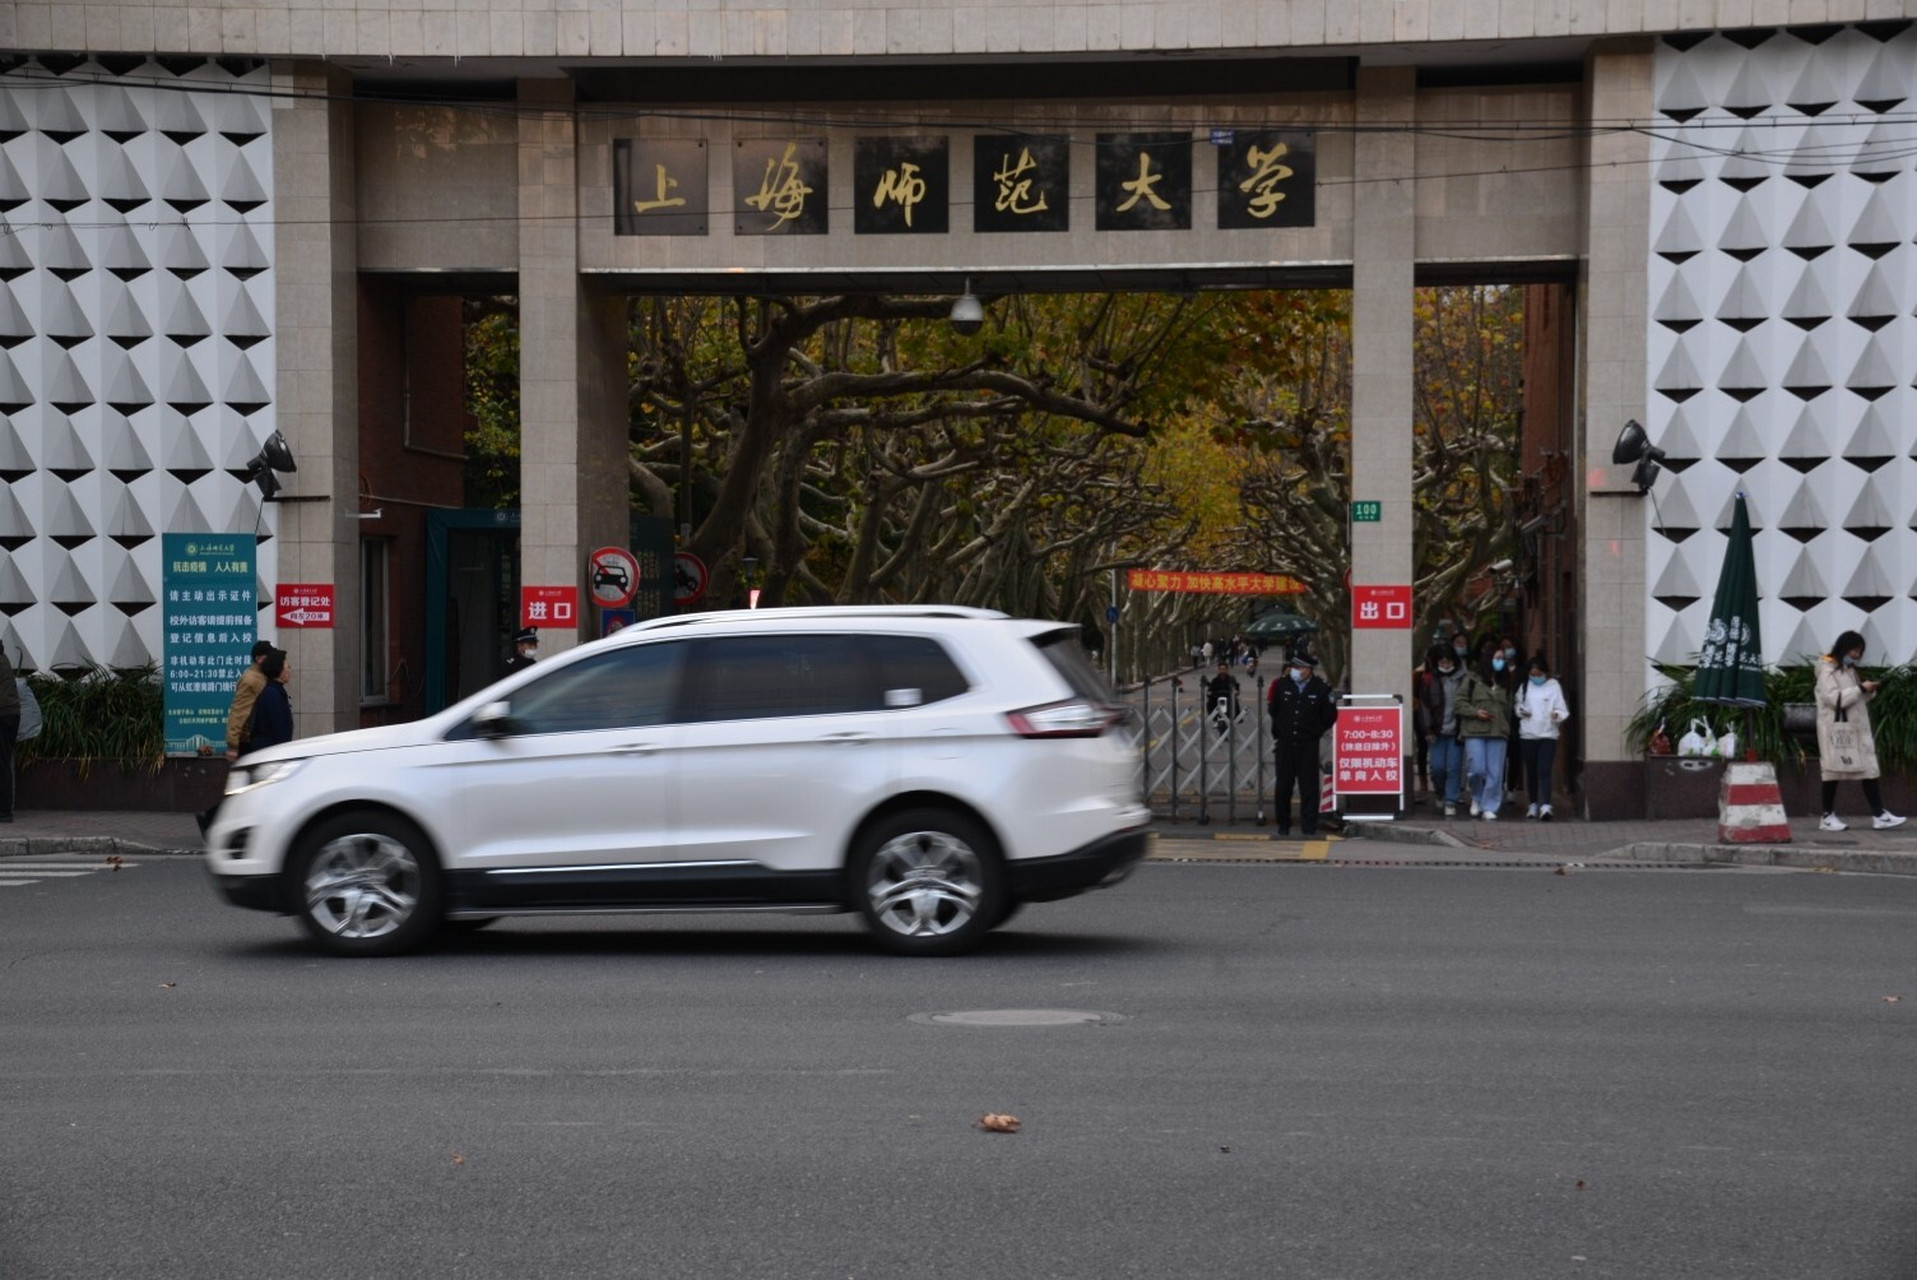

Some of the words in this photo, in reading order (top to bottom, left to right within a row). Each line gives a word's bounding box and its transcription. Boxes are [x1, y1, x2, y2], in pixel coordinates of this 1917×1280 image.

[634, 143, 1292, 231] 上海师范大学
[1356, 504, 1377, 515] 100
[173, 561, 207, 573] 抗击疫情
[215, 561, 248, 573] 人人有责
[1132, 573, 1181, 590] 凝心聚力
[169, 589, 251, 602] 请主动出示证件
[280, 596, 331, 606] 访客登记处
[528, 601, 571, 619] 进口
[1360, 601, 1405, 619] 出口
[169, 614, 252, 626] 校外访客请提前报备
[169, 632, 252, 643] 登记信息后入校
[1339, 757, 1398, 769] 仅限机动车
